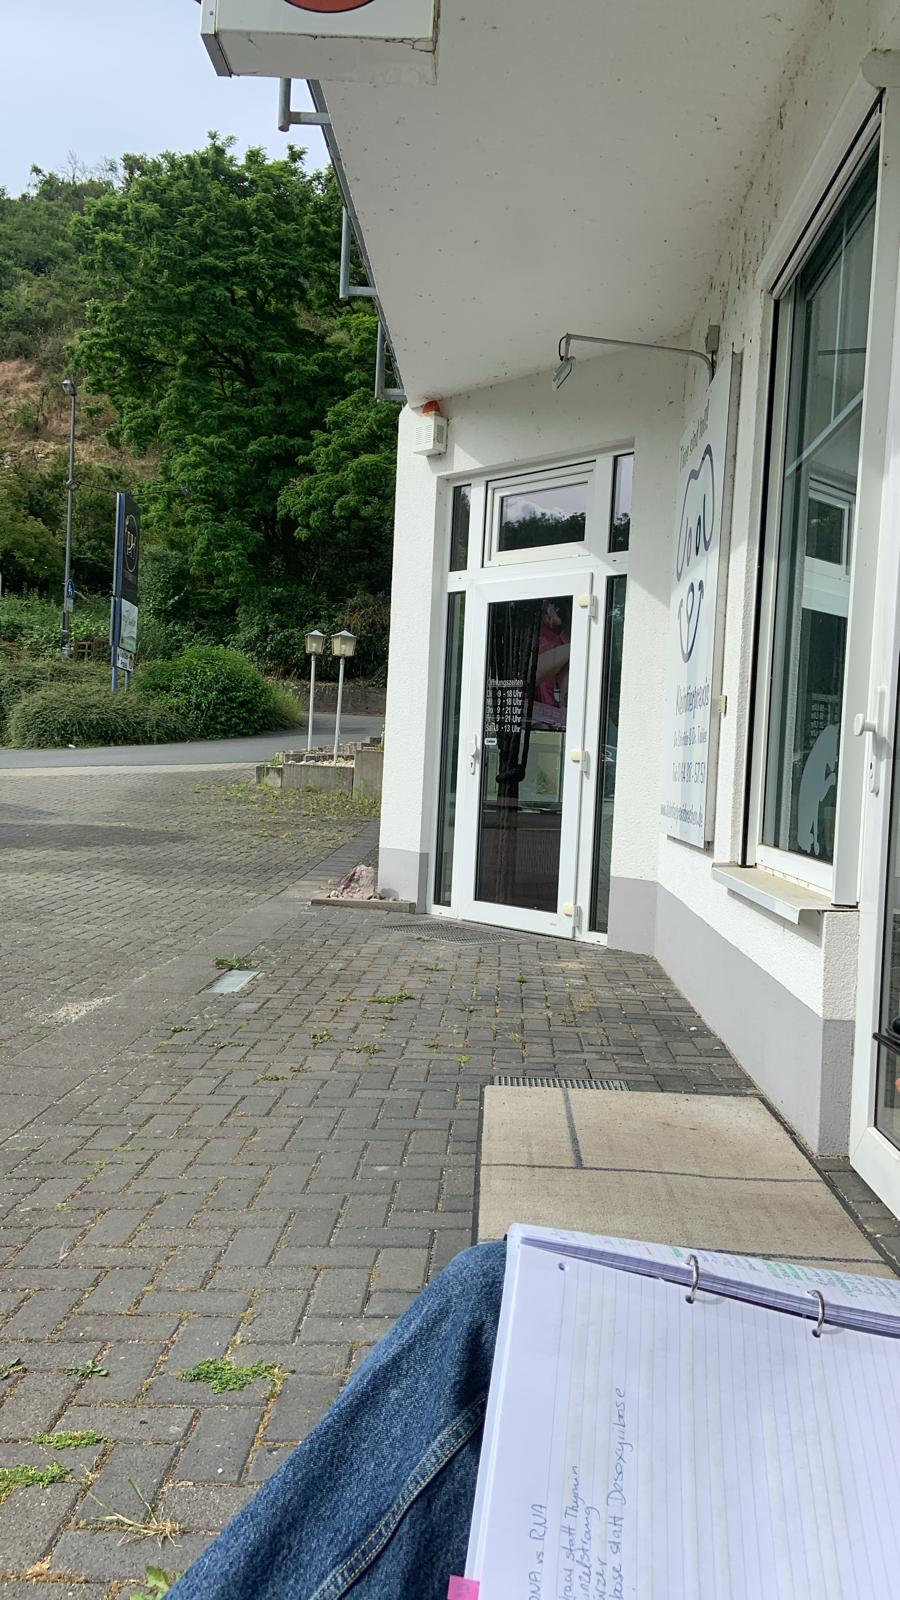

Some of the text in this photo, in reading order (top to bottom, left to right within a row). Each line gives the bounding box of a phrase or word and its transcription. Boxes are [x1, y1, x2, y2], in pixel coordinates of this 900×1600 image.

[513, 690, 523, 698] Uhr
[506, 698, 512, 706] 18
[513, 698, 522, 706] Uhr
[496, 706, 501, 714] 9
[505, 706, 511, 714] 21
[512, 706, 522, 715] Uhr
[505, 714, 511, 723] 21
[512, 714, 522, 723] Uhr
[504, 724, 511, 733] 13
[511, 724, 521, 733] Uhr
[564, 1465, 586, 1519] Thymin
[528, 1503, 549, 1542] RNA
[607, 1515, 625, 1555] statt
[559, 1524, 577, 1561] statt
